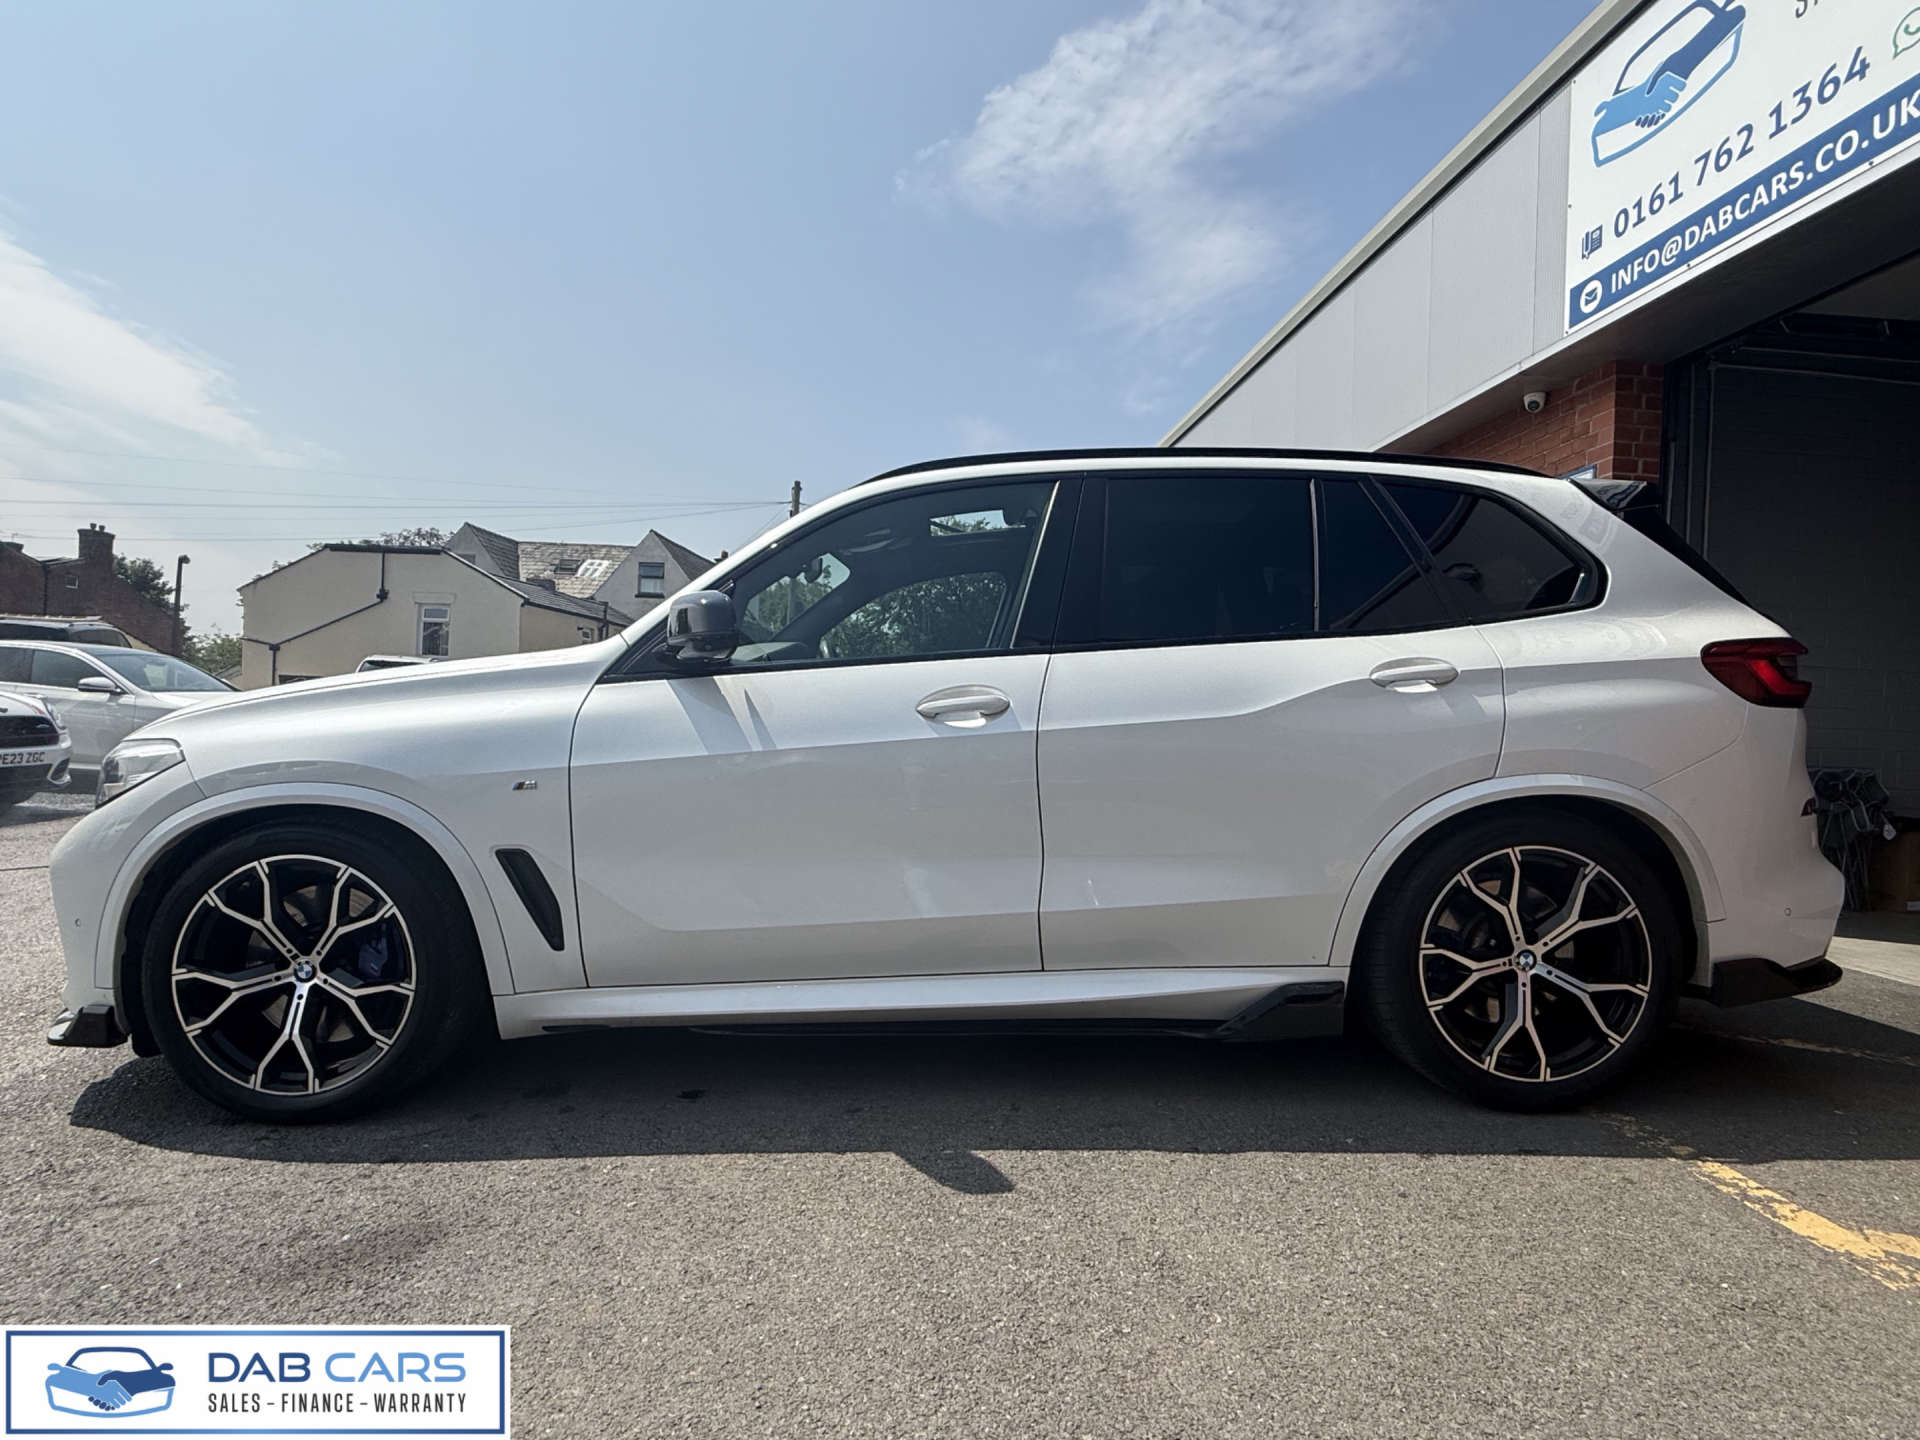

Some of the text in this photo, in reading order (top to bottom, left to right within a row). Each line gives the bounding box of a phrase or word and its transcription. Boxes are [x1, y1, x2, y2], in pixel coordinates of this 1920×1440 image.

[1611, 89, 1920, 293] INFO@DABCARS.CO.UK
[1613, 46, 1870, 238] 0161 762 1364
